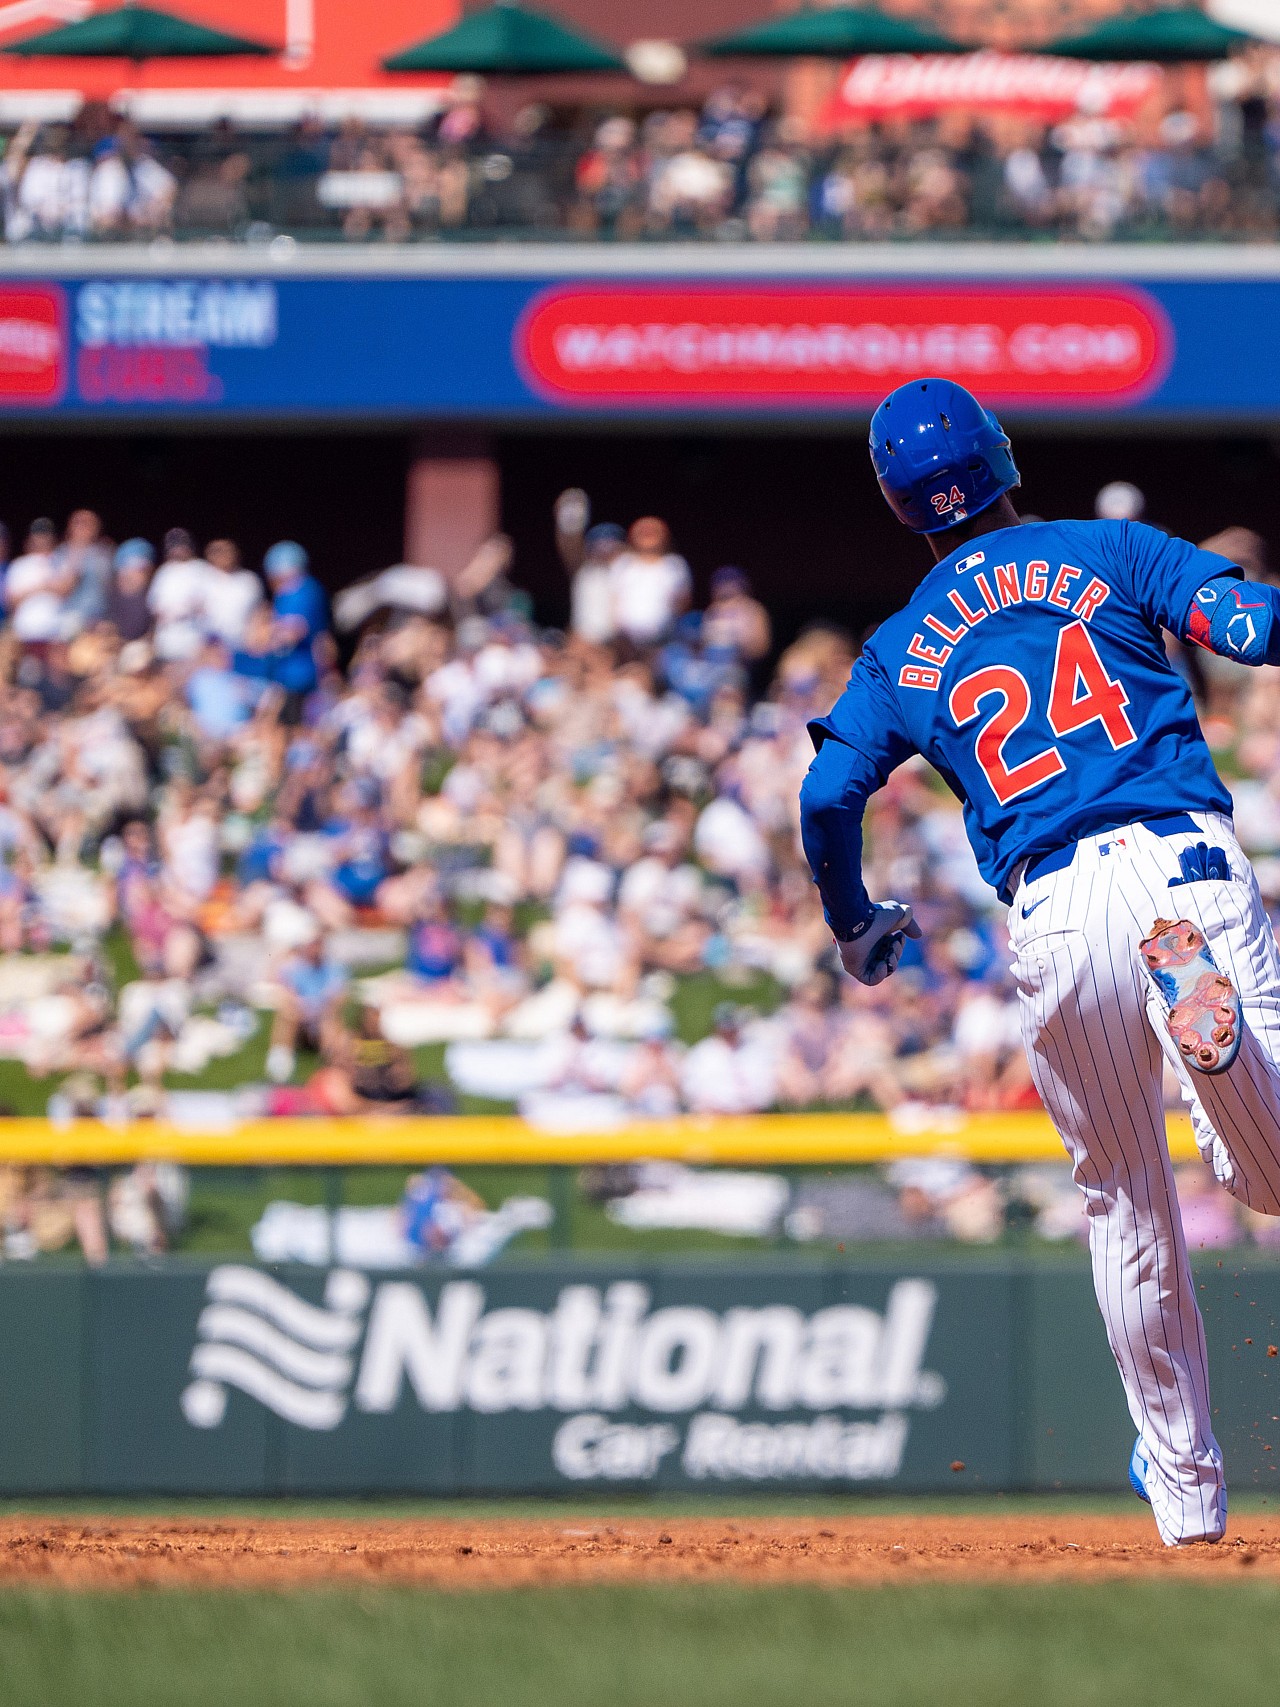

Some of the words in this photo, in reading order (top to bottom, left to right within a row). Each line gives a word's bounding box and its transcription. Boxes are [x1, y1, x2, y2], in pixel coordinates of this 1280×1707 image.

[78, 282, 278, 347] STREAM
[931, 485, 965, 515] 24
[898, 560, 1110, 692] BELLINGER
[948, 618, 1138, 806] 24
[356, 1278, 936, 1413] National
[552, 1414, 678, 1480] Car
[683, 1412, 908, 1481] Rental
